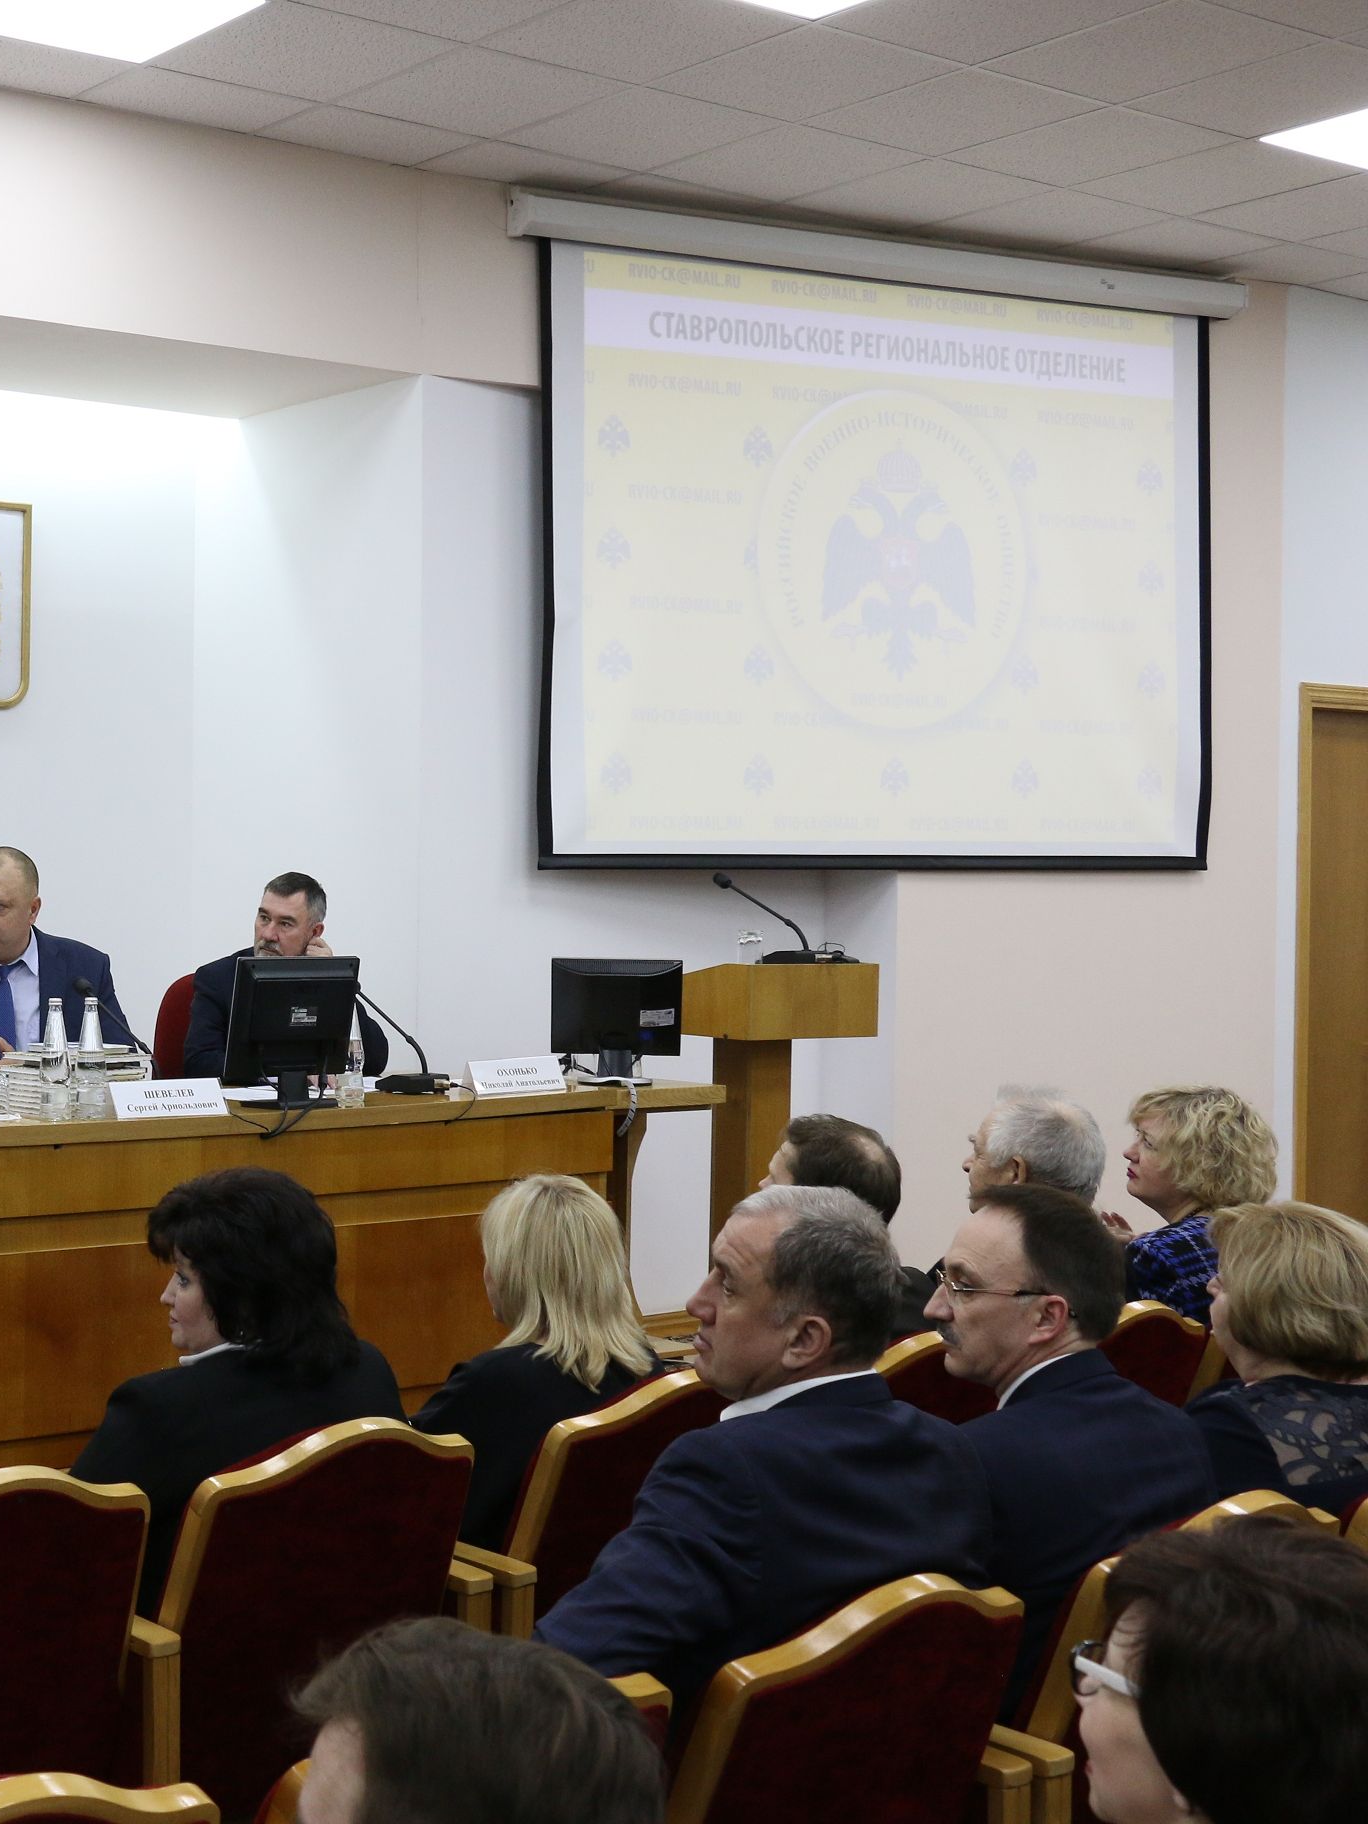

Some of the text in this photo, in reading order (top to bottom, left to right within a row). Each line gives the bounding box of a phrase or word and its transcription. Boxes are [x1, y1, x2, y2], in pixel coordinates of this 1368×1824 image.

[648, 310, 1127, 383] СТАВРОПОЛЬСКОЕ РЕГИОНАЛЬНОЕ ОТДЕЛЕНИЕ
[497, 1067, 538, 1077] ОХОНЬКО
[144, 1089, 194, 1099] ШЕВЕЛЕВ
[127, 1101, 218, 1114] Сергей Арнольдович
